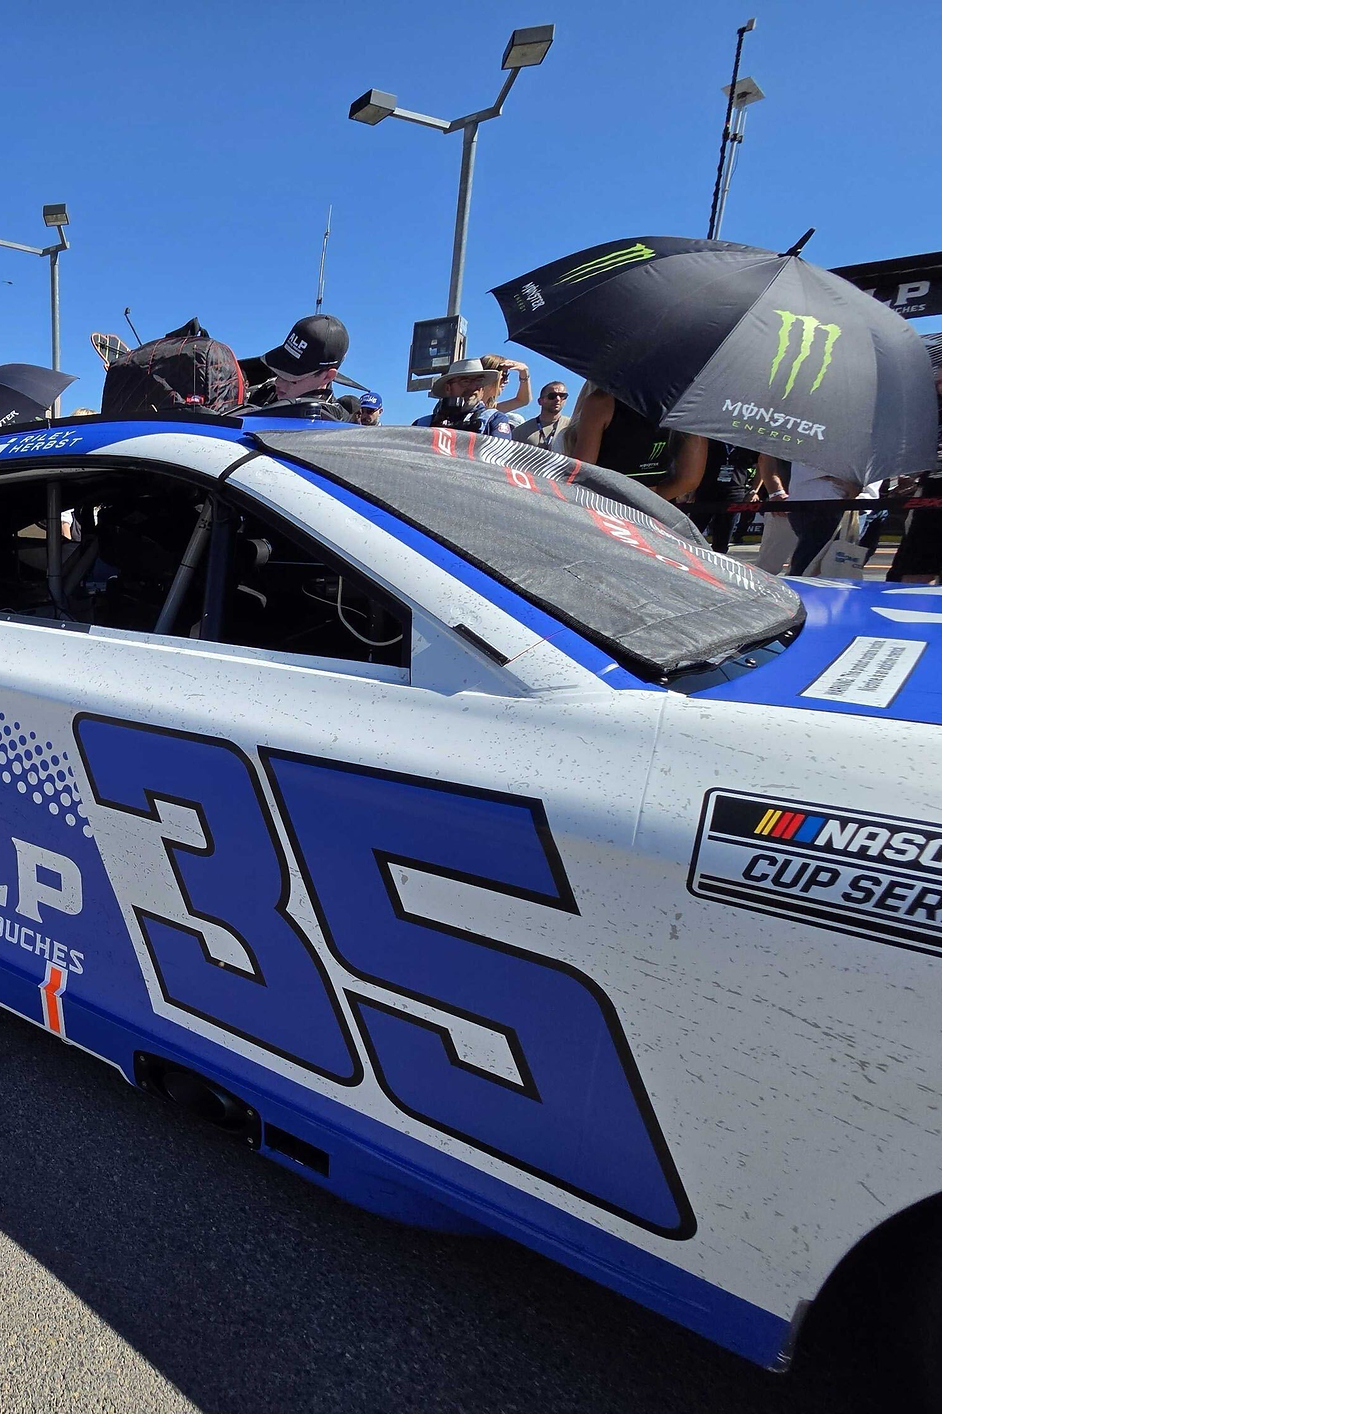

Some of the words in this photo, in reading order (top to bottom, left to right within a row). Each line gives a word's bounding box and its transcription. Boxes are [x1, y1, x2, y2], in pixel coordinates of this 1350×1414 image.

[289, 333, 308, 349] ALP
[722, 399, 826, 440] MONSTER
[9, 437, 83, 453] HERBST
[20, 431, 76, 443] RILEY
[732, 420, 803, 445] ENERGY
[742, 853, 841, 893] CUP
[72, 711, 698, 1241] 35
